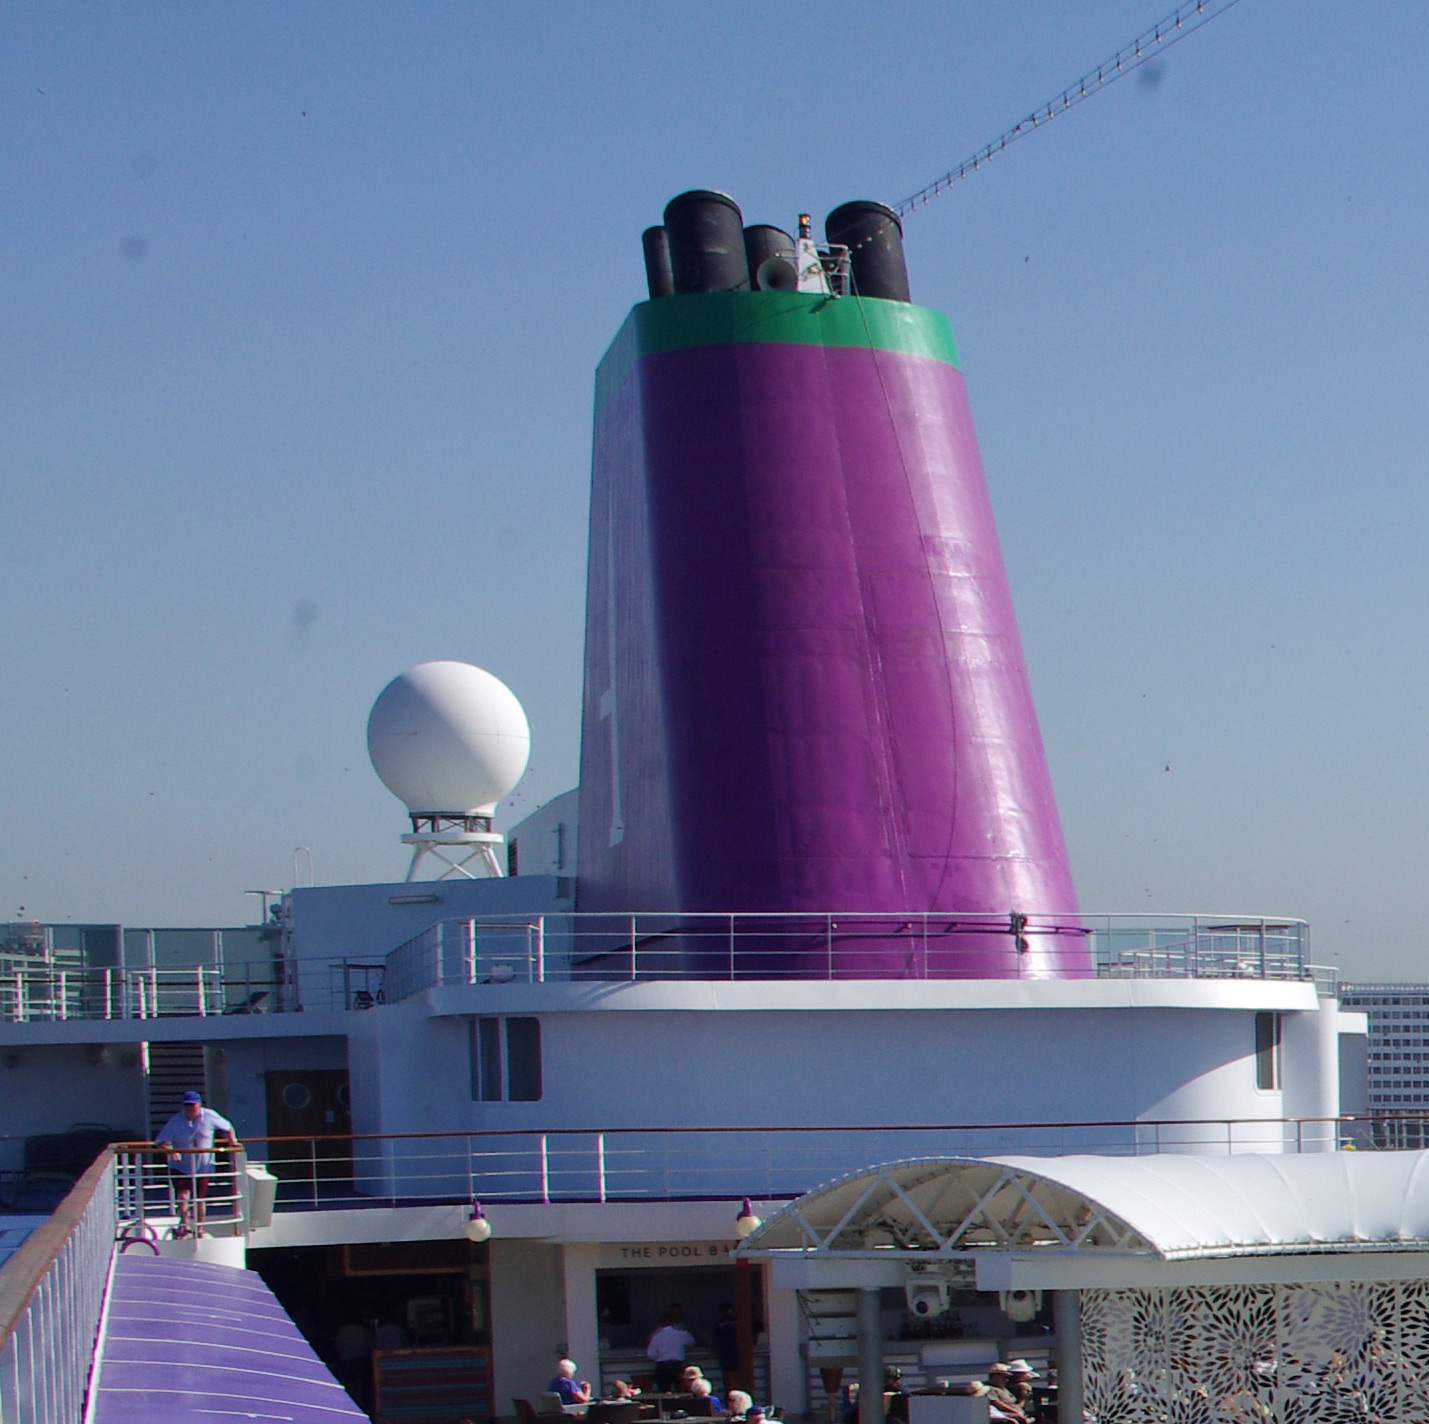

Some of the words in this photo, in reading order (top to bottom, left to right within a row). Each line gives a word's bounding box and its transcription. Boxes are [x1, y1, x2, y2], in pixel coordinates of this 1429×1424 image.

[621, 1248, 651, 1257] THE
[659, 1246, 701, 1258] POOL
[709, 1244, 738, 1255] BA
